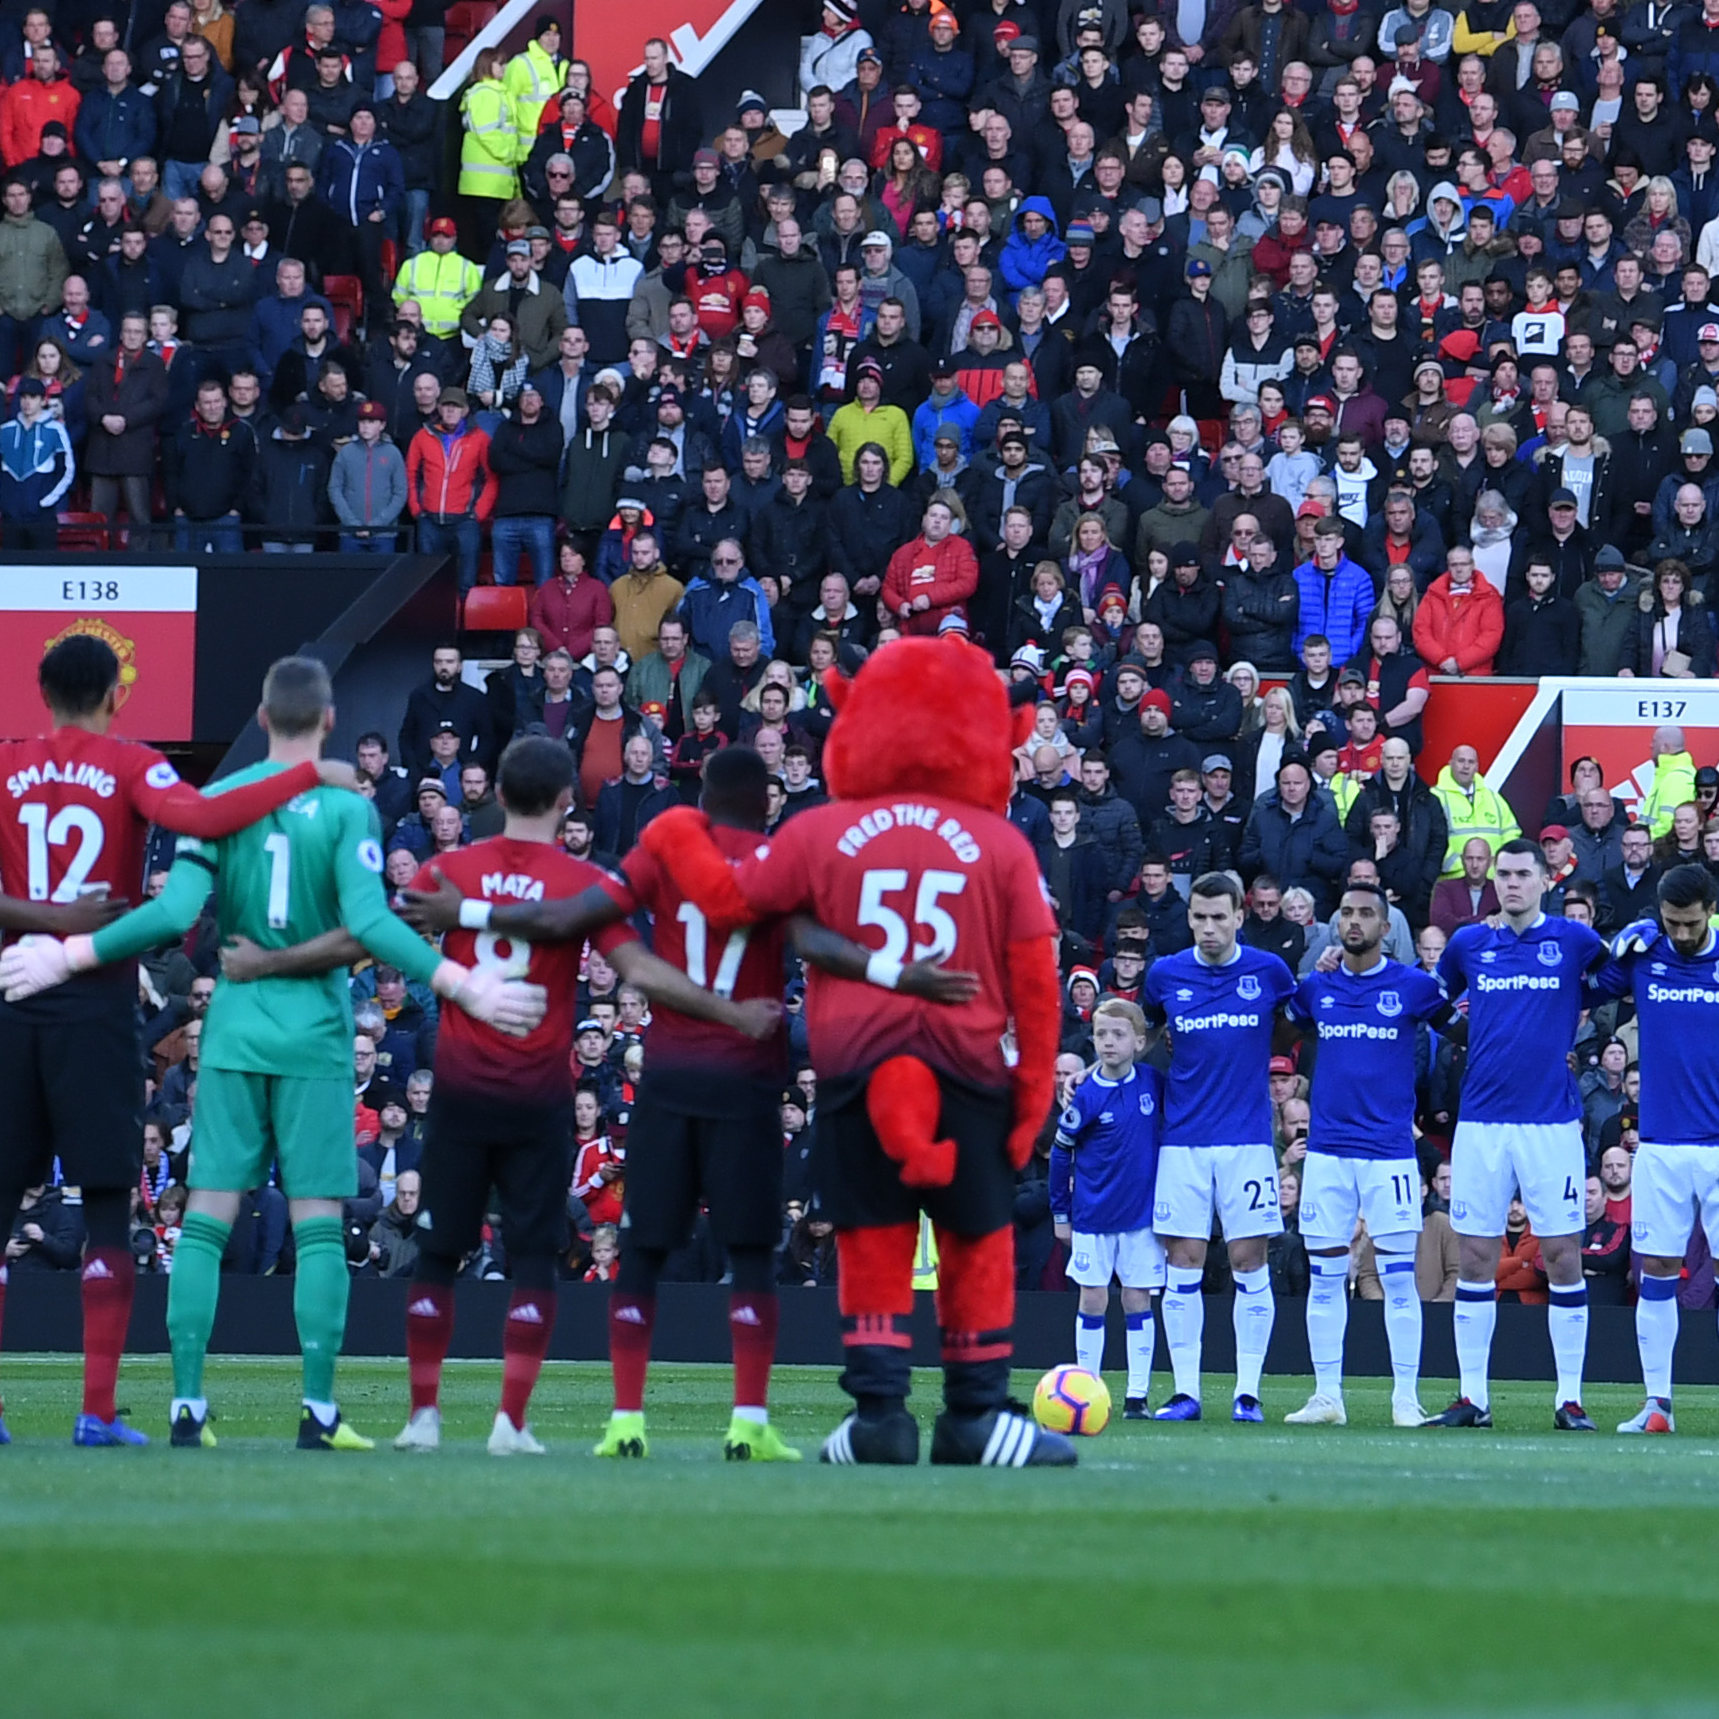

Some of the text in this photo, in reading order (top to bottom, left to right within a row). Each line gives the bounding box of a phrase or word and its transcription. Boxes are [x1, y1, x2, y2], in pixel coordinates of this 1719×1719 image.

[61, 580, 119, 600] E138
[1638, 701, 1686, 718] E137
[837, 803, 981, 863] FRED THE RED
[19, 803, 104, 903] 12
[265, 834, 290, 929] 1
[482, 872, 544, 902] MATA
[857, 868, 968, 966] 55
[1477, 973, 1560, 993] SportPesa
[1175, 1013, 1259, 1034] SportPesa
[1318, 1020, 1398, 1041] SportPesa
[1243, 1176, 1278, 1211] 23
[1391, 1174, 1412, 1205] 11
[1563, 1175, 1579, 1204] 4
